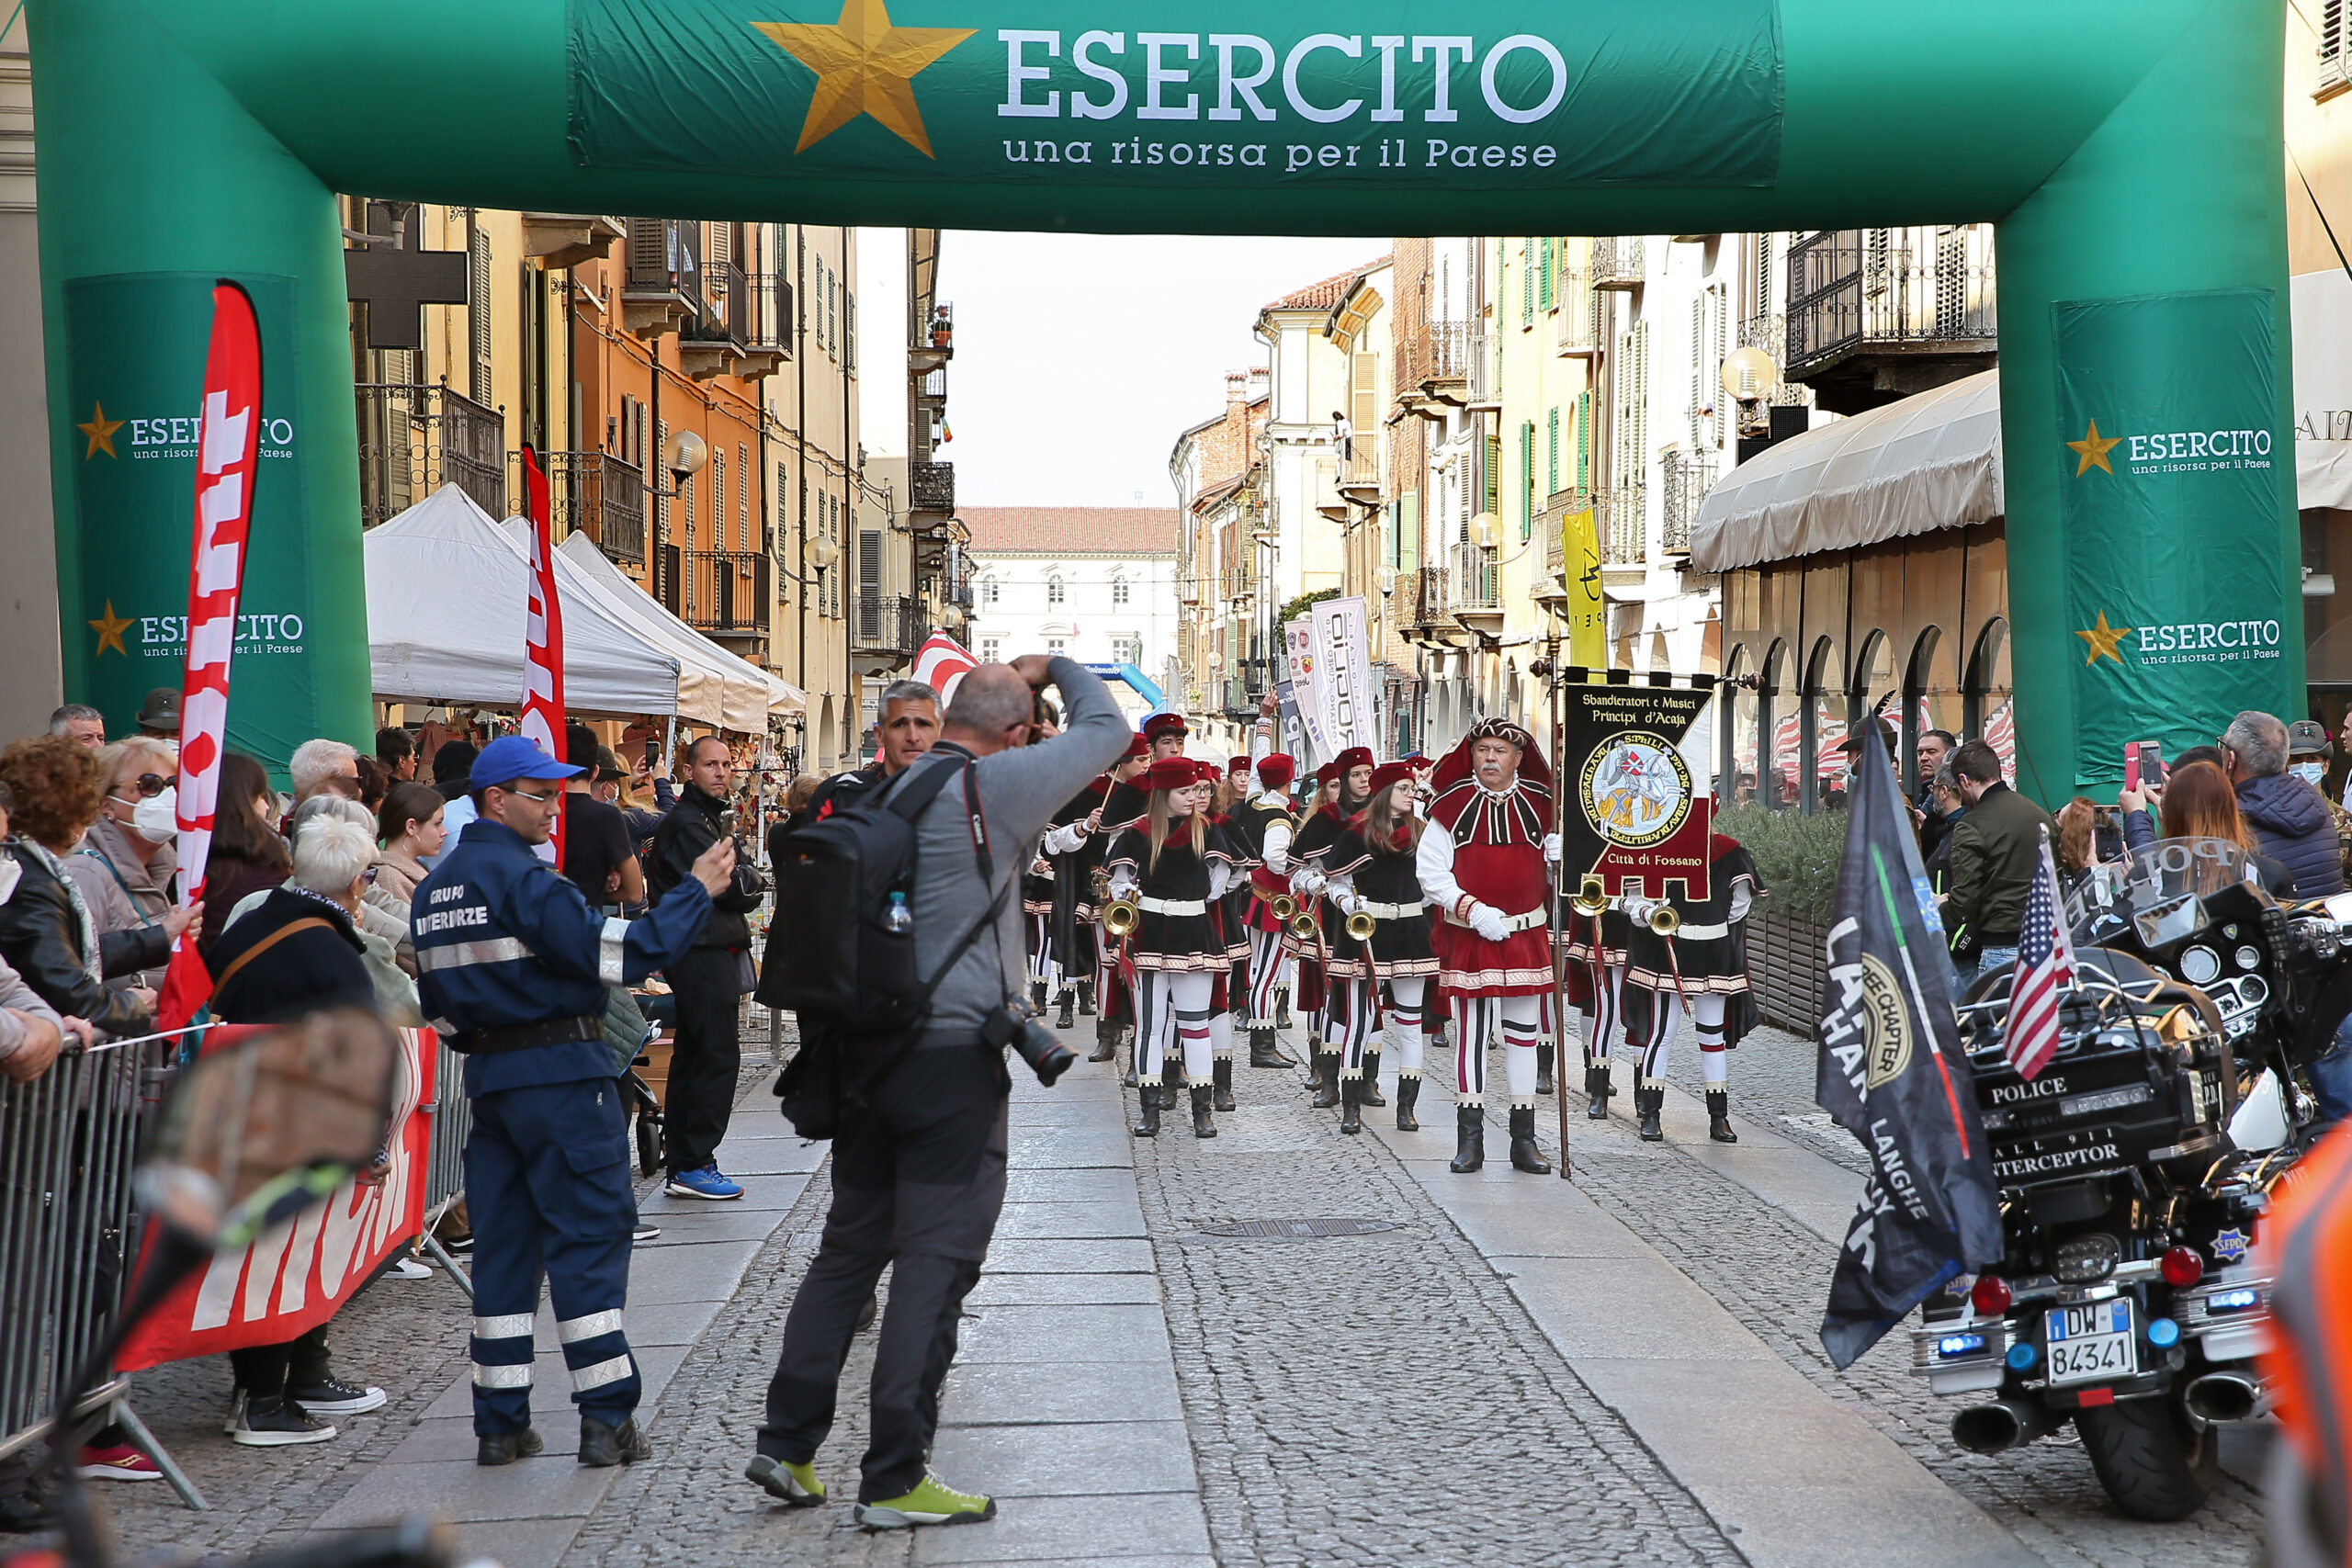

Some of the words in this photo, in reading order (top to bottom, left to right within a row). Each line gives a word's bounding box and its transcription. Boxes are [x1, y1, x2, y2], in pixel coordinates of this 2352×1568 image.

[997, 29, 1568, 124] ESERCITO
[1003, 140, 1092, 165] una
[1112, 138, 1267, 168] risorsa
[1286, 143, 1367, 173] per
[1379, 139, 1406, 167] il
[1426, 141, 1557, 168] Paese
[133, 450, 159, 459] una
[164, 448, 199, 458] risors
[2129, 429, 2271, 461] ESERCITO
[2132, 466, 2158, 475] una
[2163, 462, 2207, 473] risorsa
[2211, 460, 2231, 472] per
[2234, 459, 2242, 468] il
[2245, 459, 2270, 469] Paese
[235, 645, 249, 653] er
[254, 644, 262, 653] il
[266, 644, 303, 654] Paese
[2138, 619, 2280, 652] ESERCITO
[143, 647, 169, 657] una
[2142, 656, 2167, 665] una
[2171, 652, 2216, 663] risorsa
[2220, 651, 2240, 661] per
[2243, 649, 2250, 660] il
[2254, 649, 2279, 660] Paese
[1582, 694, 1650, 707] Sbandieratori
[1662, 697, 1696, 709] Musici
[1592, 710, 1636, 726] Principi
[1608, 852, 1634, 865] Città
[1638, 853, 1650, 865] di
[1655, 855, 1702, 866] Fossano
[1876, 992, 1903, 1073] CHAPTER
[1992, 1077, 2067, 1104] POLICE
[1995, 1141, 2043, 1158] ALL
[2069, 1128, 2113, 1145] 911
[1870, 1118, 1929, 1220] LANGHE
[1992, 1144, 2120, 1178] NTERCEPTOR
[2068, 1306, 2098, 1336] DW
[2052, 1339, 2126, 1375] 84341
